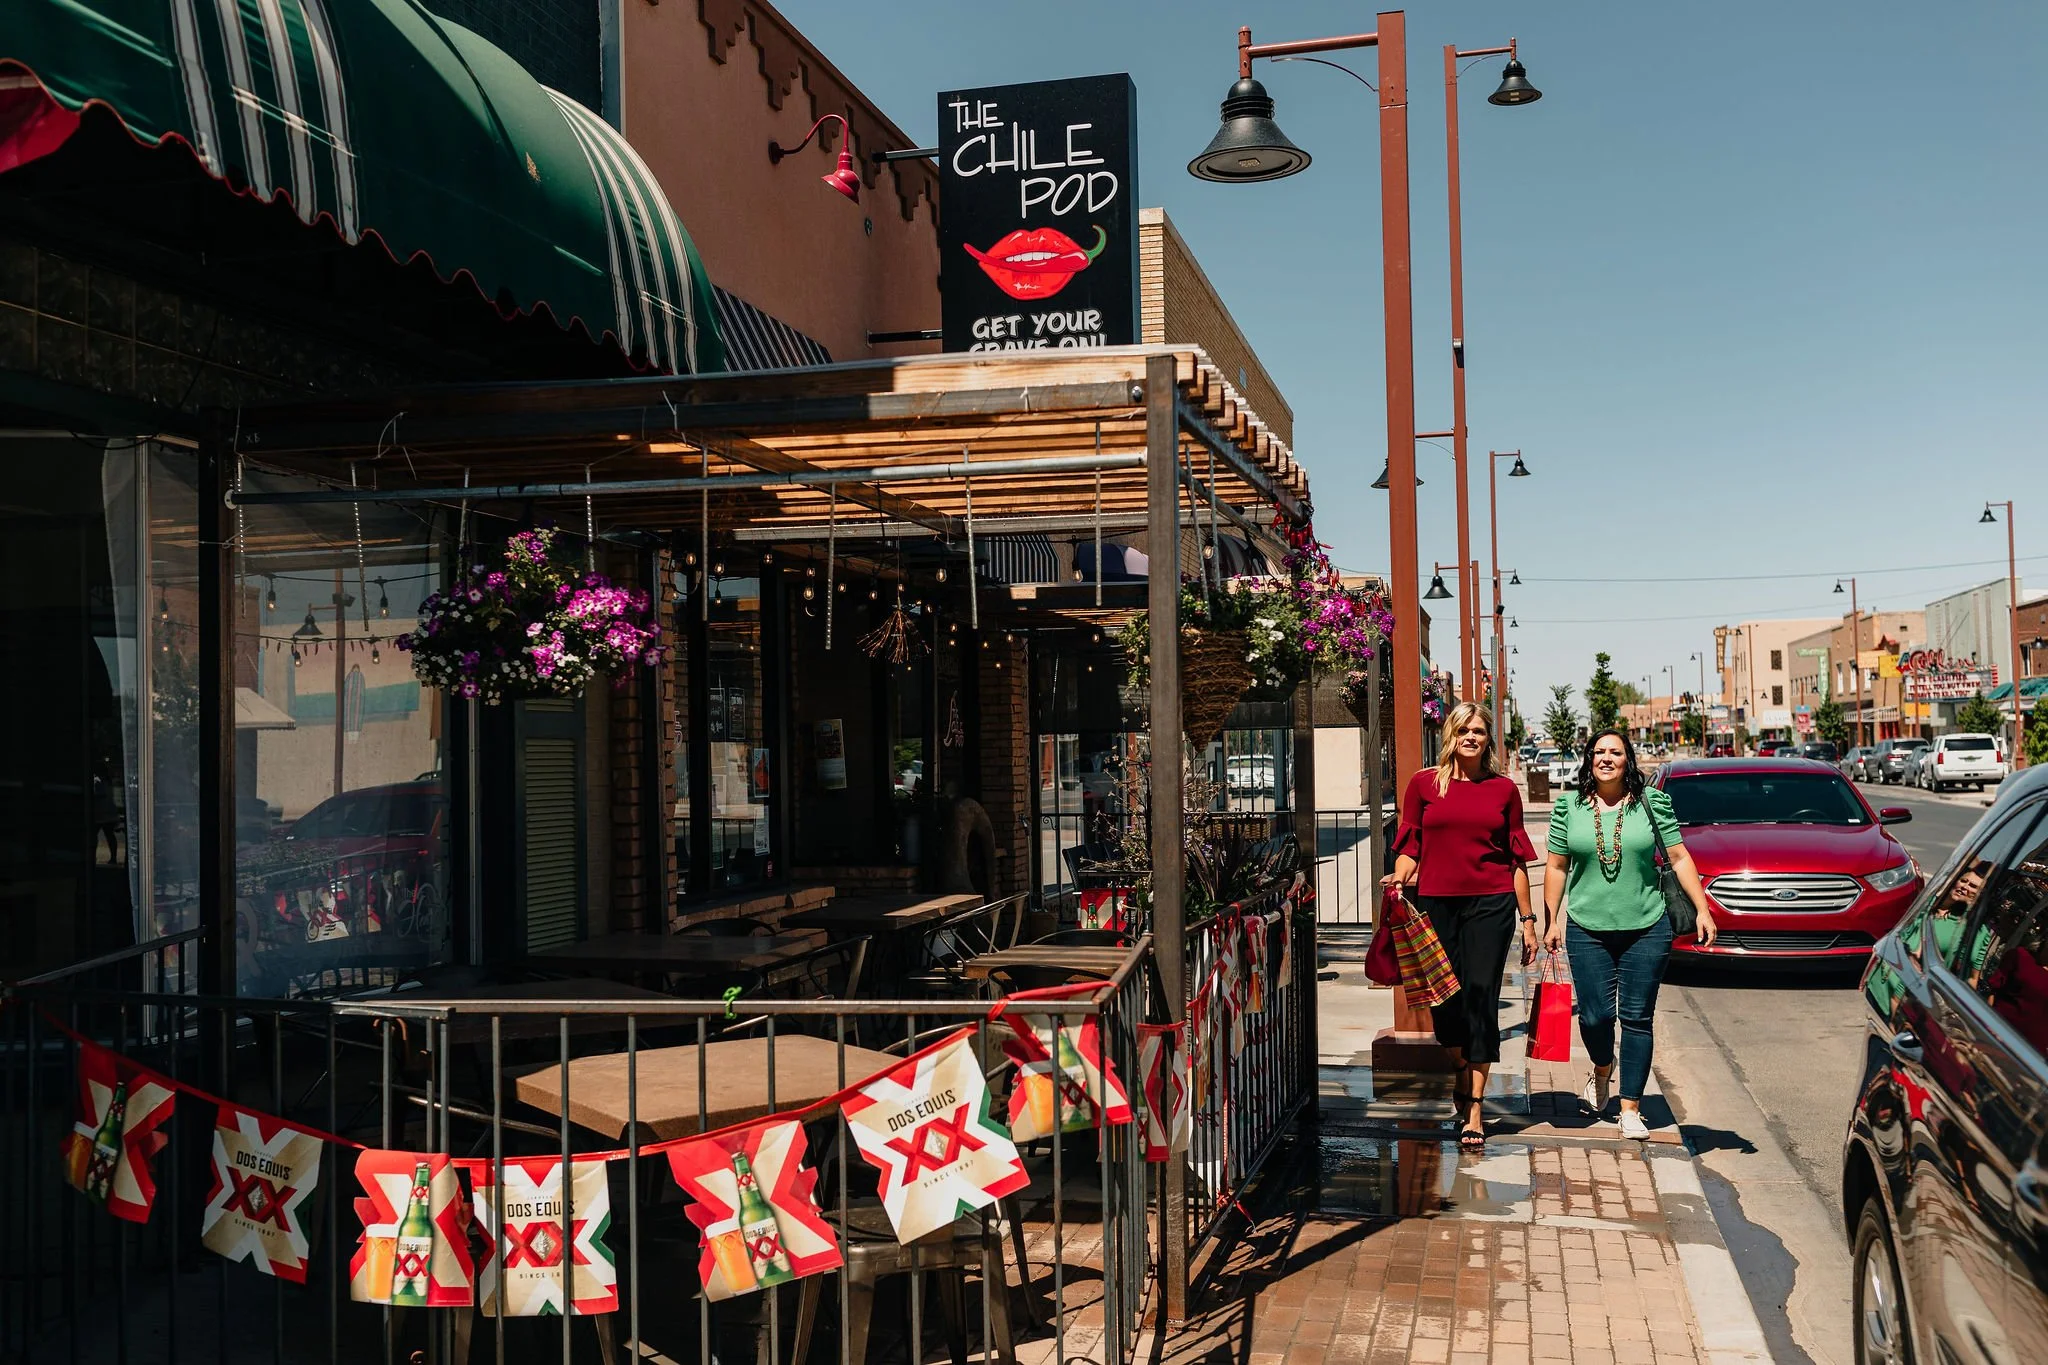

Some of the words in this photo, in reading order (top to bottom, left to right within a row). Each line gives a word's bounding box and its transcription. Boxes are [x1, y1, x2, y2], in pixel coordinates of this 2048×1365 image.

[948, 100, 1004, 133] THE
[952, 121, 1105, 178] CHILE
[1021, 171, 1118, 219] POD
[971, 314, 1023, 340] GET
[1030, 309, 1103, 336] YOUR
[888, 1109, 916, 1133] DOS
[915, 1089, 957, 1119] EQUIS
[236, 1150, 257, 1170] DOS
[258, 1157, 292, 1181] EQUIS
[507, 1203, 532, 1218] DOS
[536, 1200, 576, 1216] EQUS
